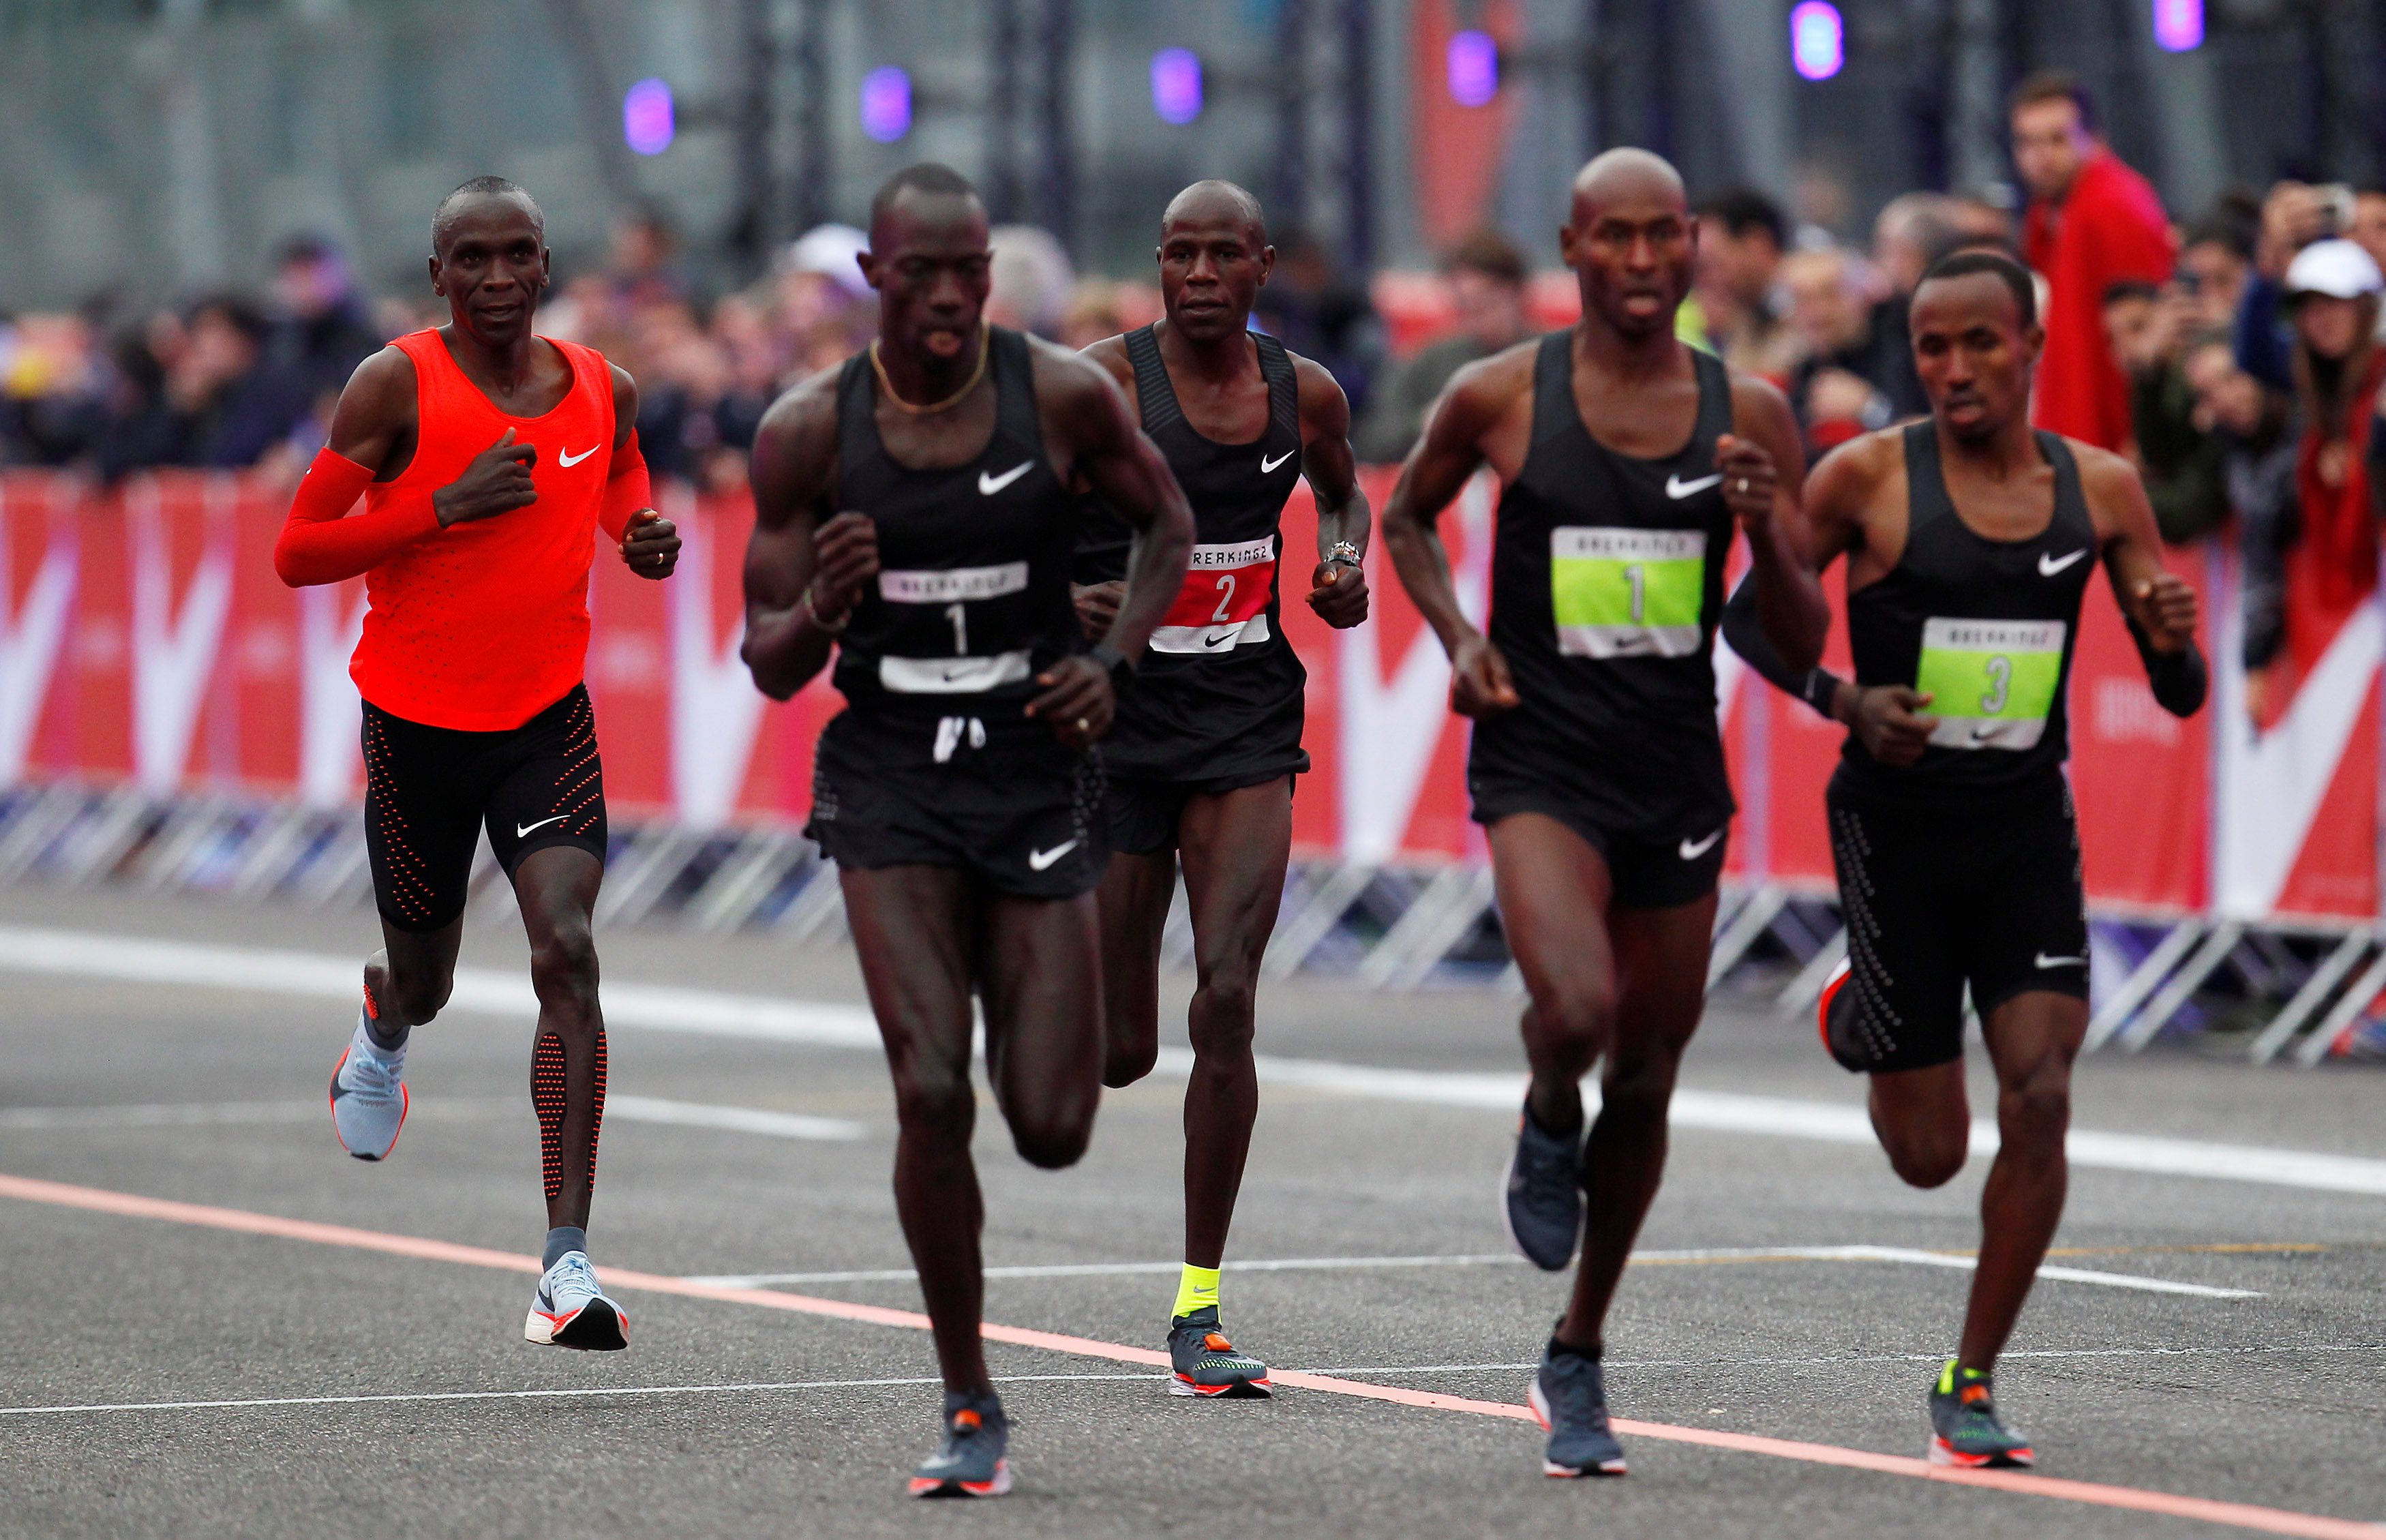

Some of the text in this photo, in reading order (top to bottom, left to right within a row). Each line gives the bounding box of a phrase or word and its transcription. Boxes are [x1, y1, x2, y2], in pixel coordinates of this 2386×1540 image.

[1192, 545, 1267, 564] REAKING2
[1211, 575, 1236, 622] 2
[1624, 564, 1645, 623] 1
[944, 603, 968, 655] 1
[1981, 655, 2011, 714] 3
